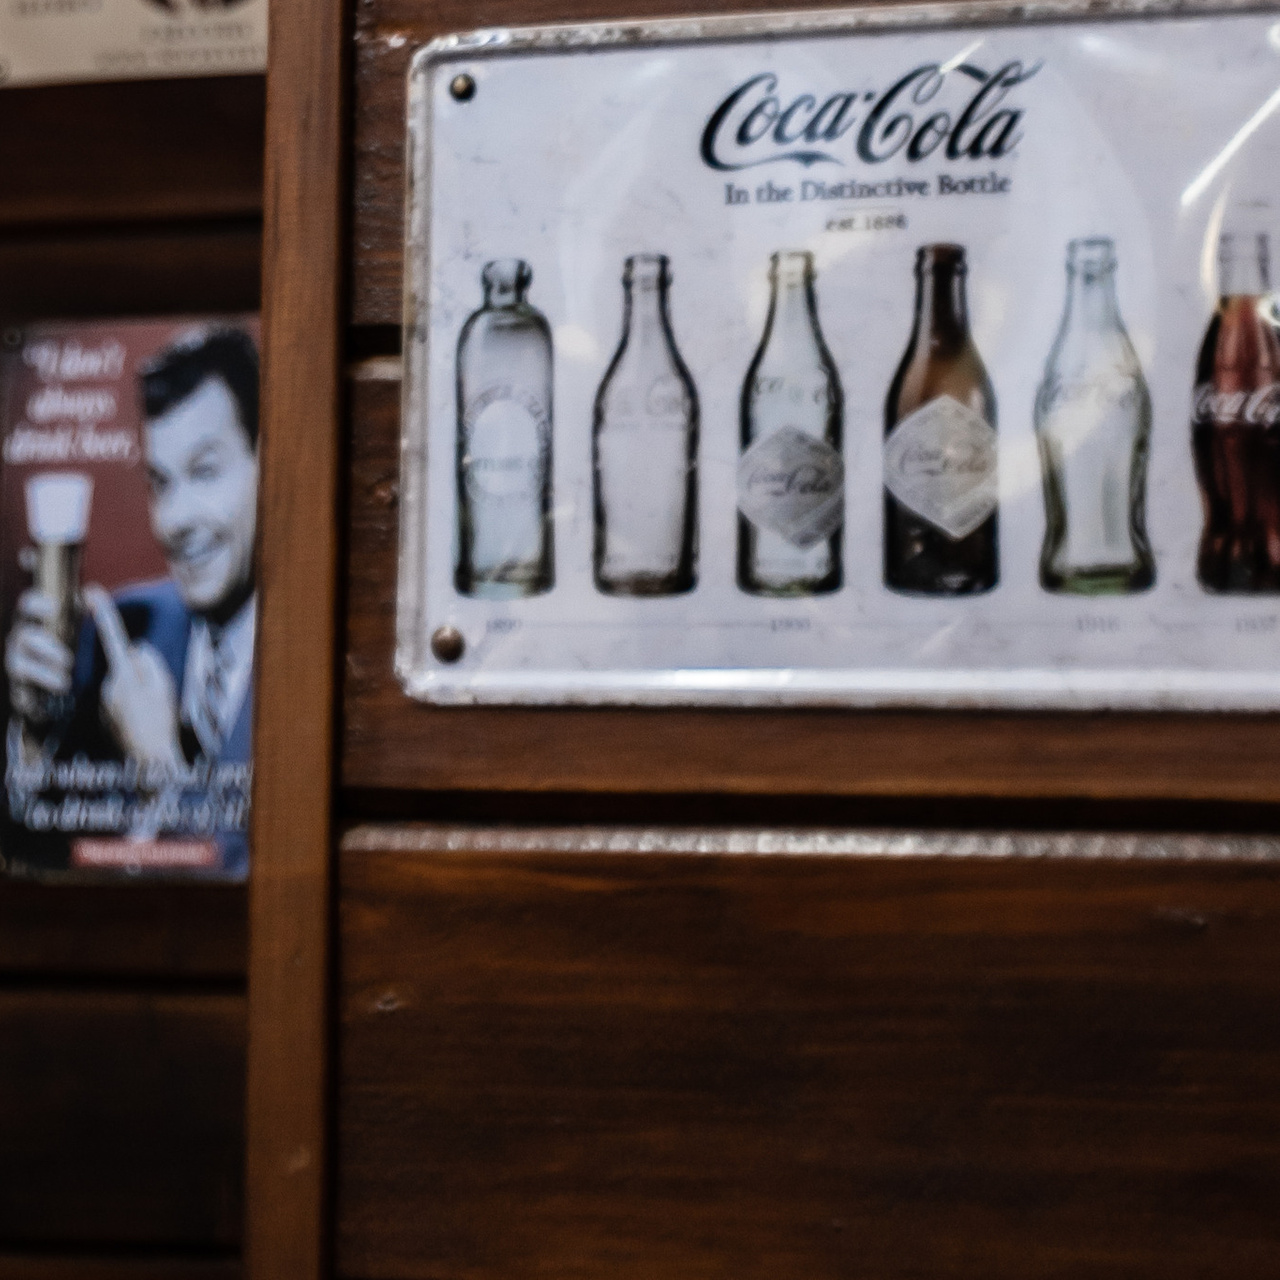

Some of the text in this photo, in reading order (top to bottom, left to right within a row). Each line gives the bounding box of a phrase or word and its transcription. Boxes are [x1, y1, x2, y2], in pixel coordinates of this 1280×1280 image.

[700, 58, 1046, 172] Coca-Cola
[724, 171, 1012, 205] In the Distinctive Bottle
